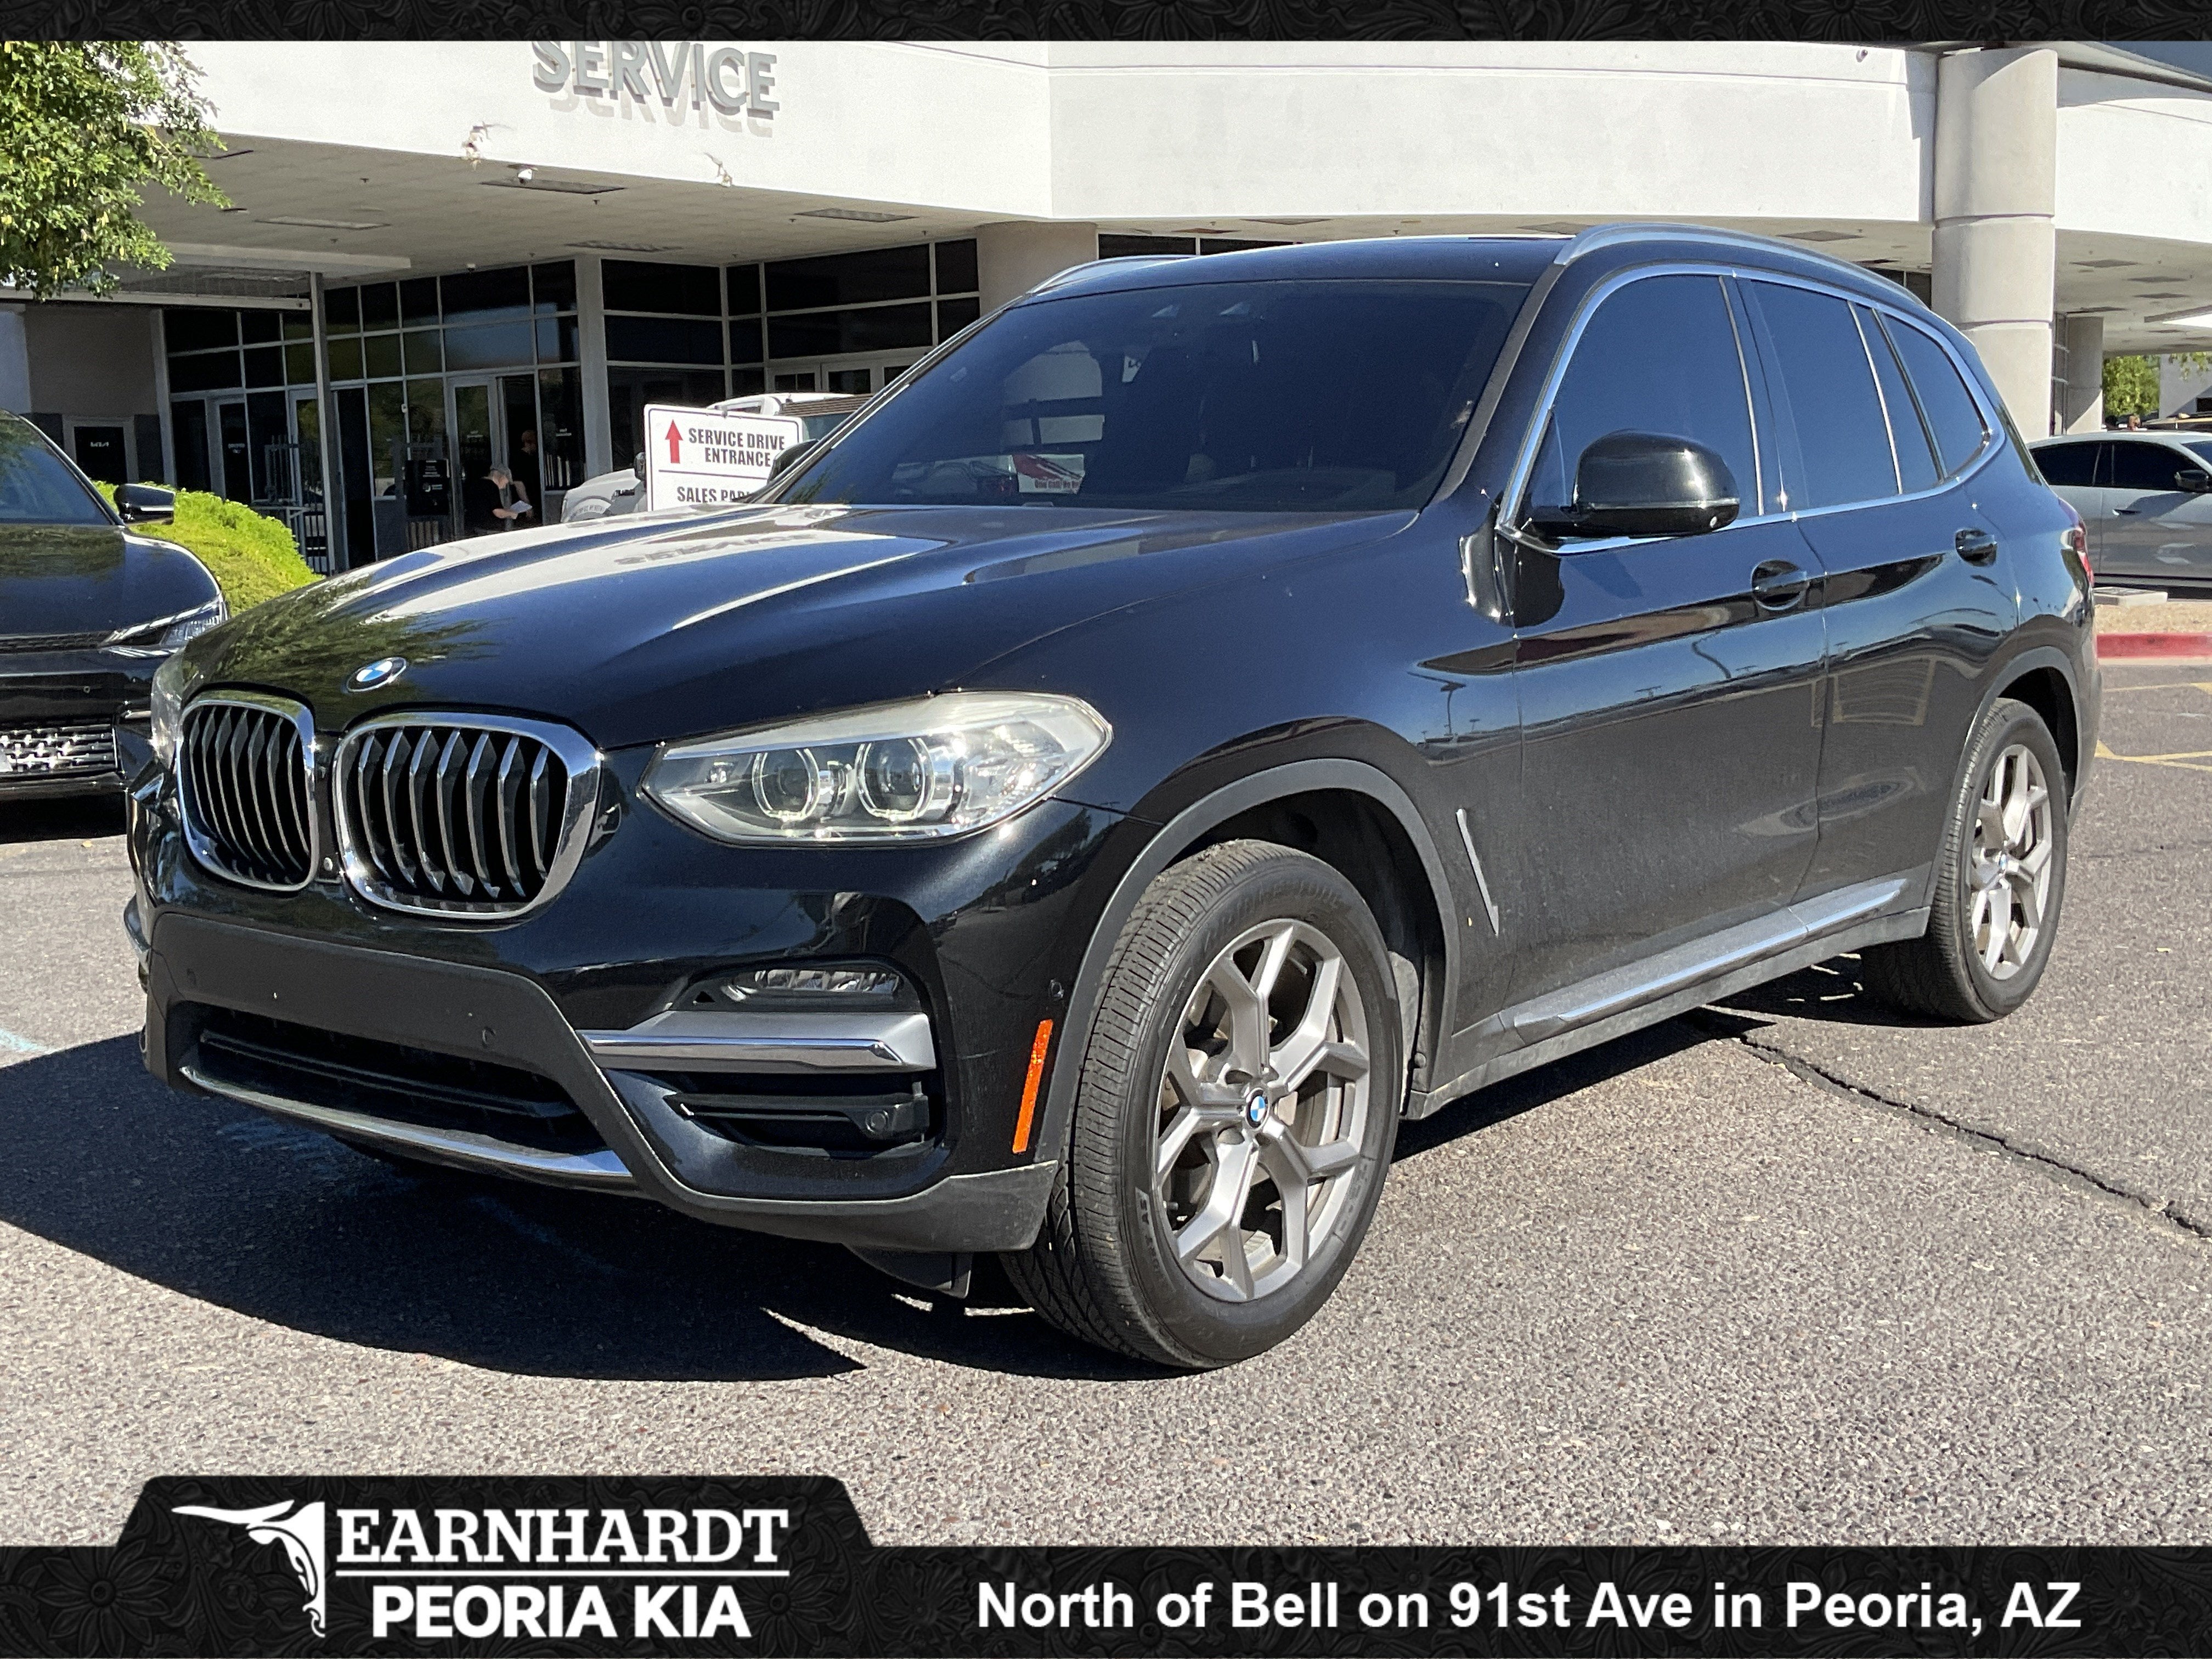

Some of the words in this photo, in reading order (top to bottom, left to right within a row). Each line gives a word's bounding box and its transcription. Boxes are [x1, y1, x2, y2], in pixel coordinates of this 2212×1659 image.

[533, 41, 780, 114] SERVICE
[689, 427, 743, 448] SERVICE
[747, 433, 785, 450] DRIVE
[705, 447, 771, 467] ENTRANCE
[677, 486, 717, 503] SALES
